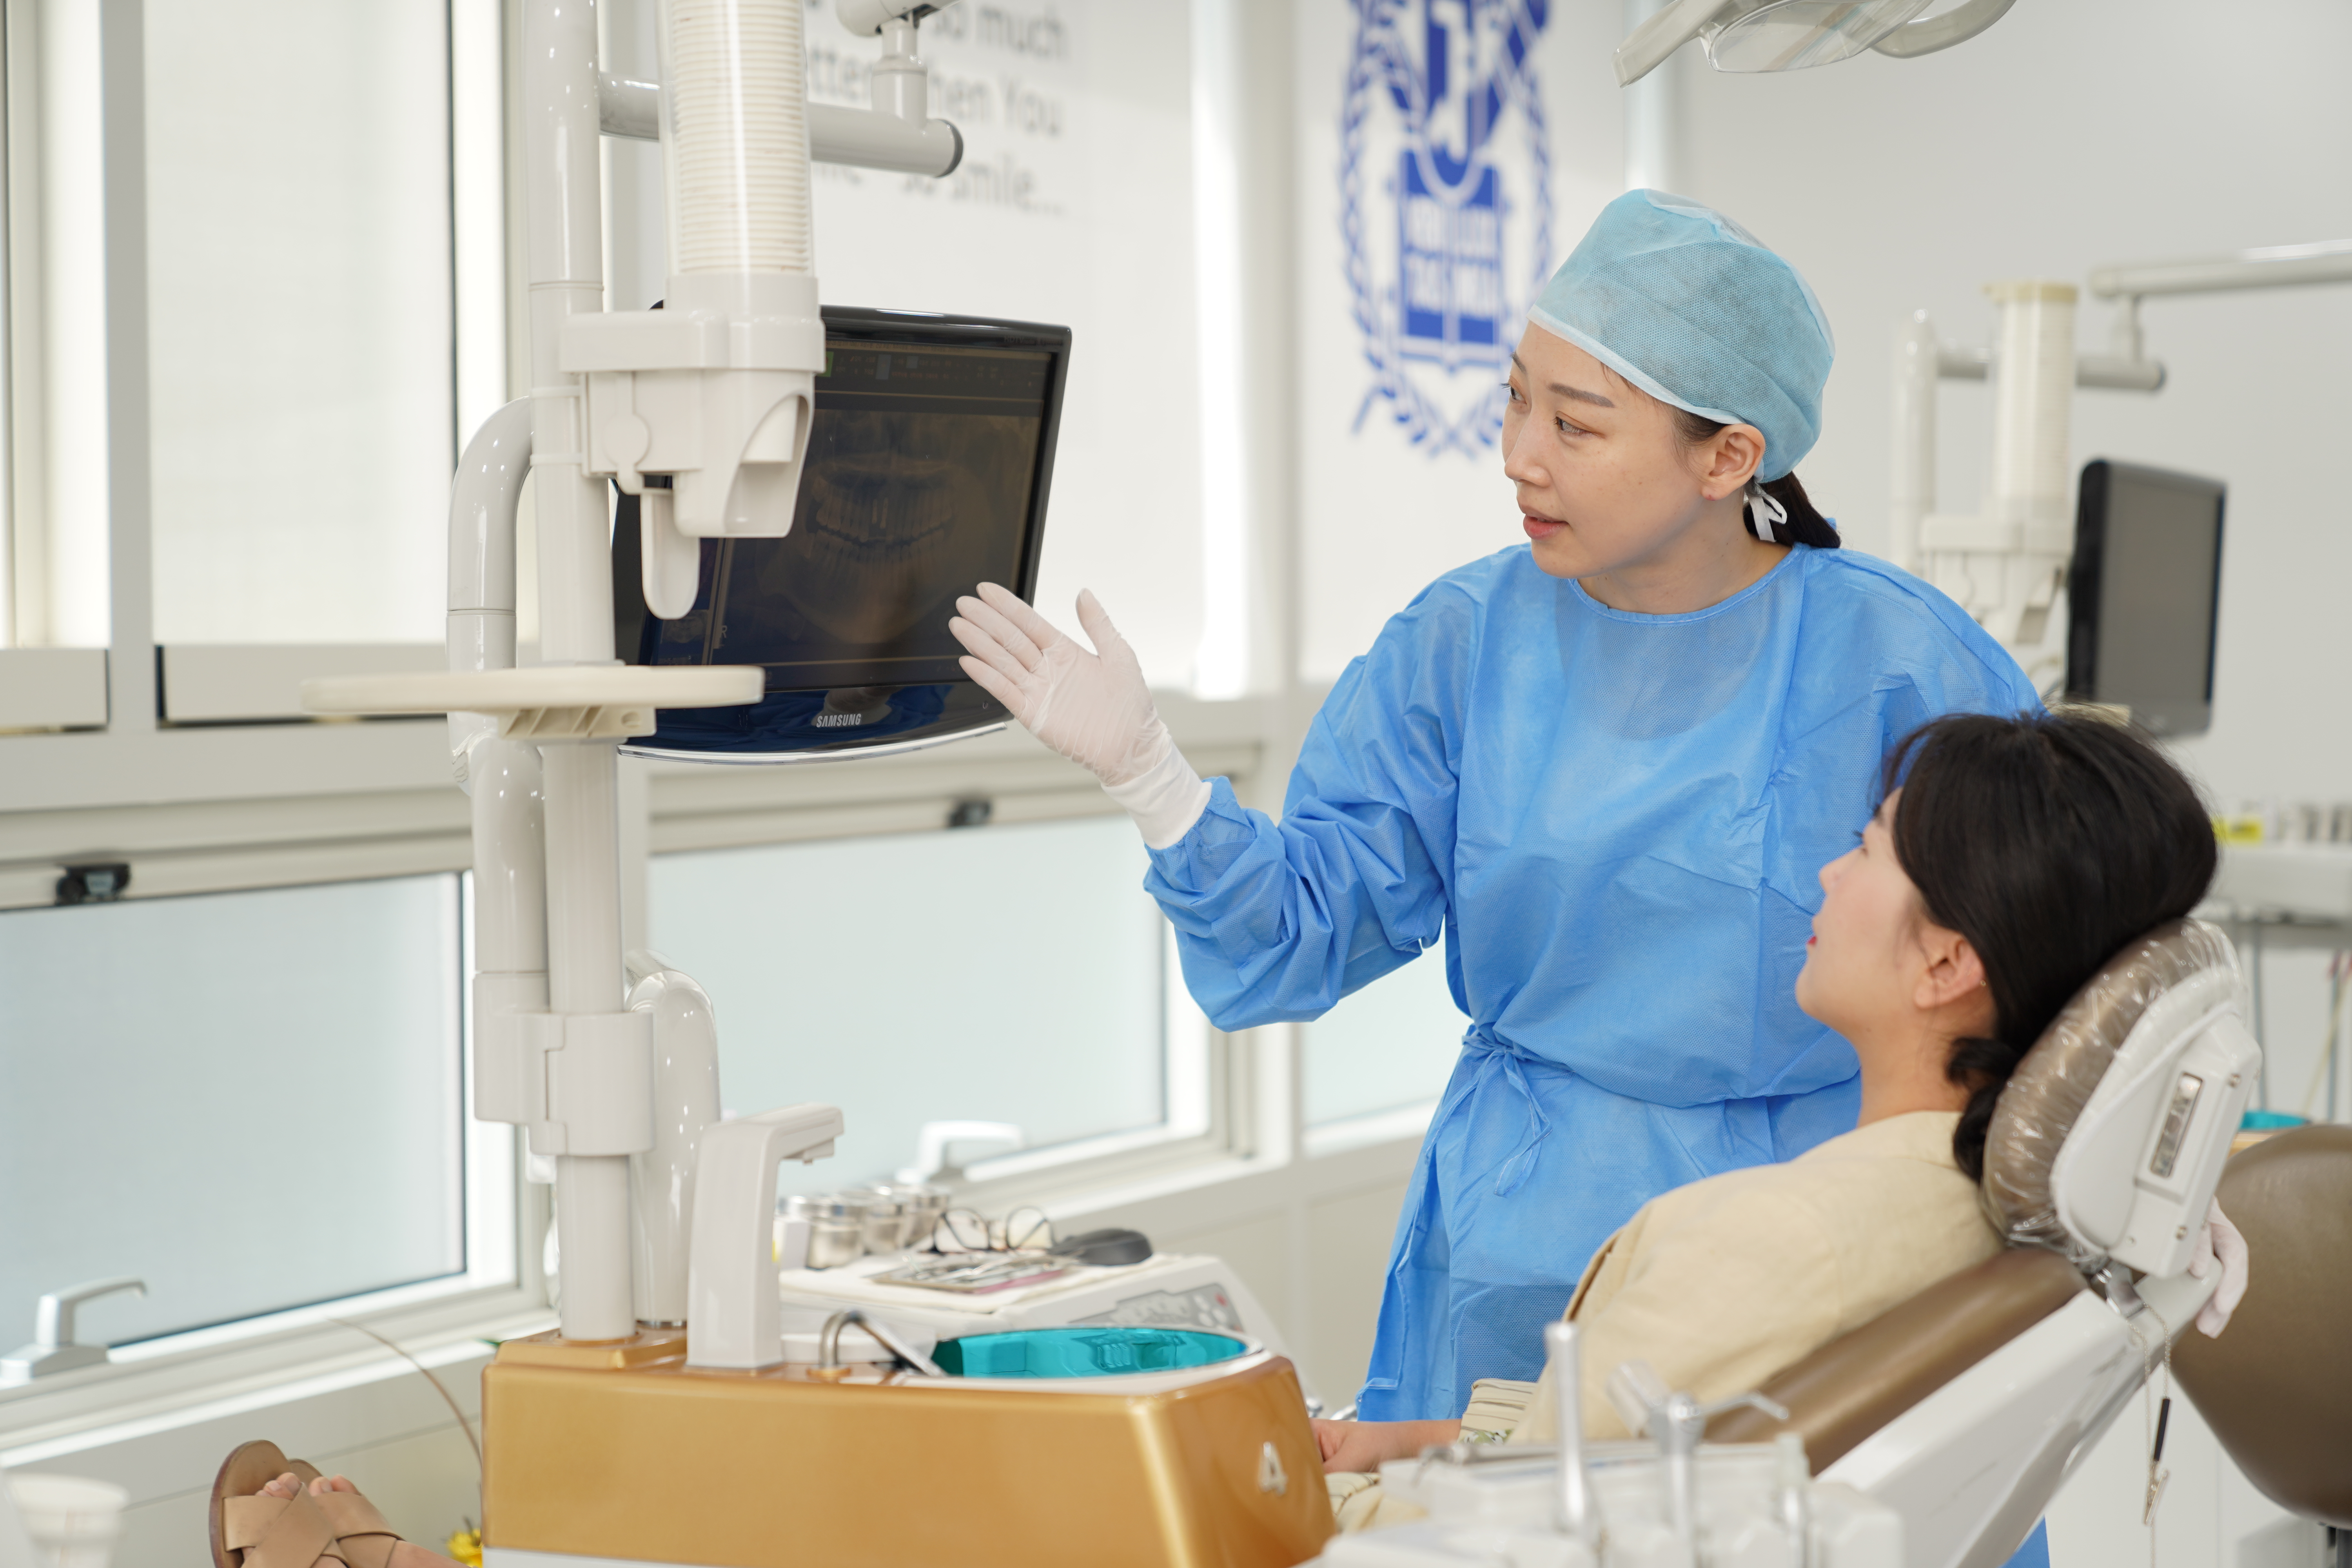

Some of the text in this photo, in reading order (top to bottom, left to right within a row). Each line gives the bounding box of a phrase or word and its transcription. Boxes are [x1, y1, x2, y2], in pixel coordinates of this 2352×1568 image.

[976, 3, 1070, 60] much
[929, 59, 993, 125] hen
[816, 713, 862, 728] SAMSUNG
[1257, 1441, 1289, 1496] 4
